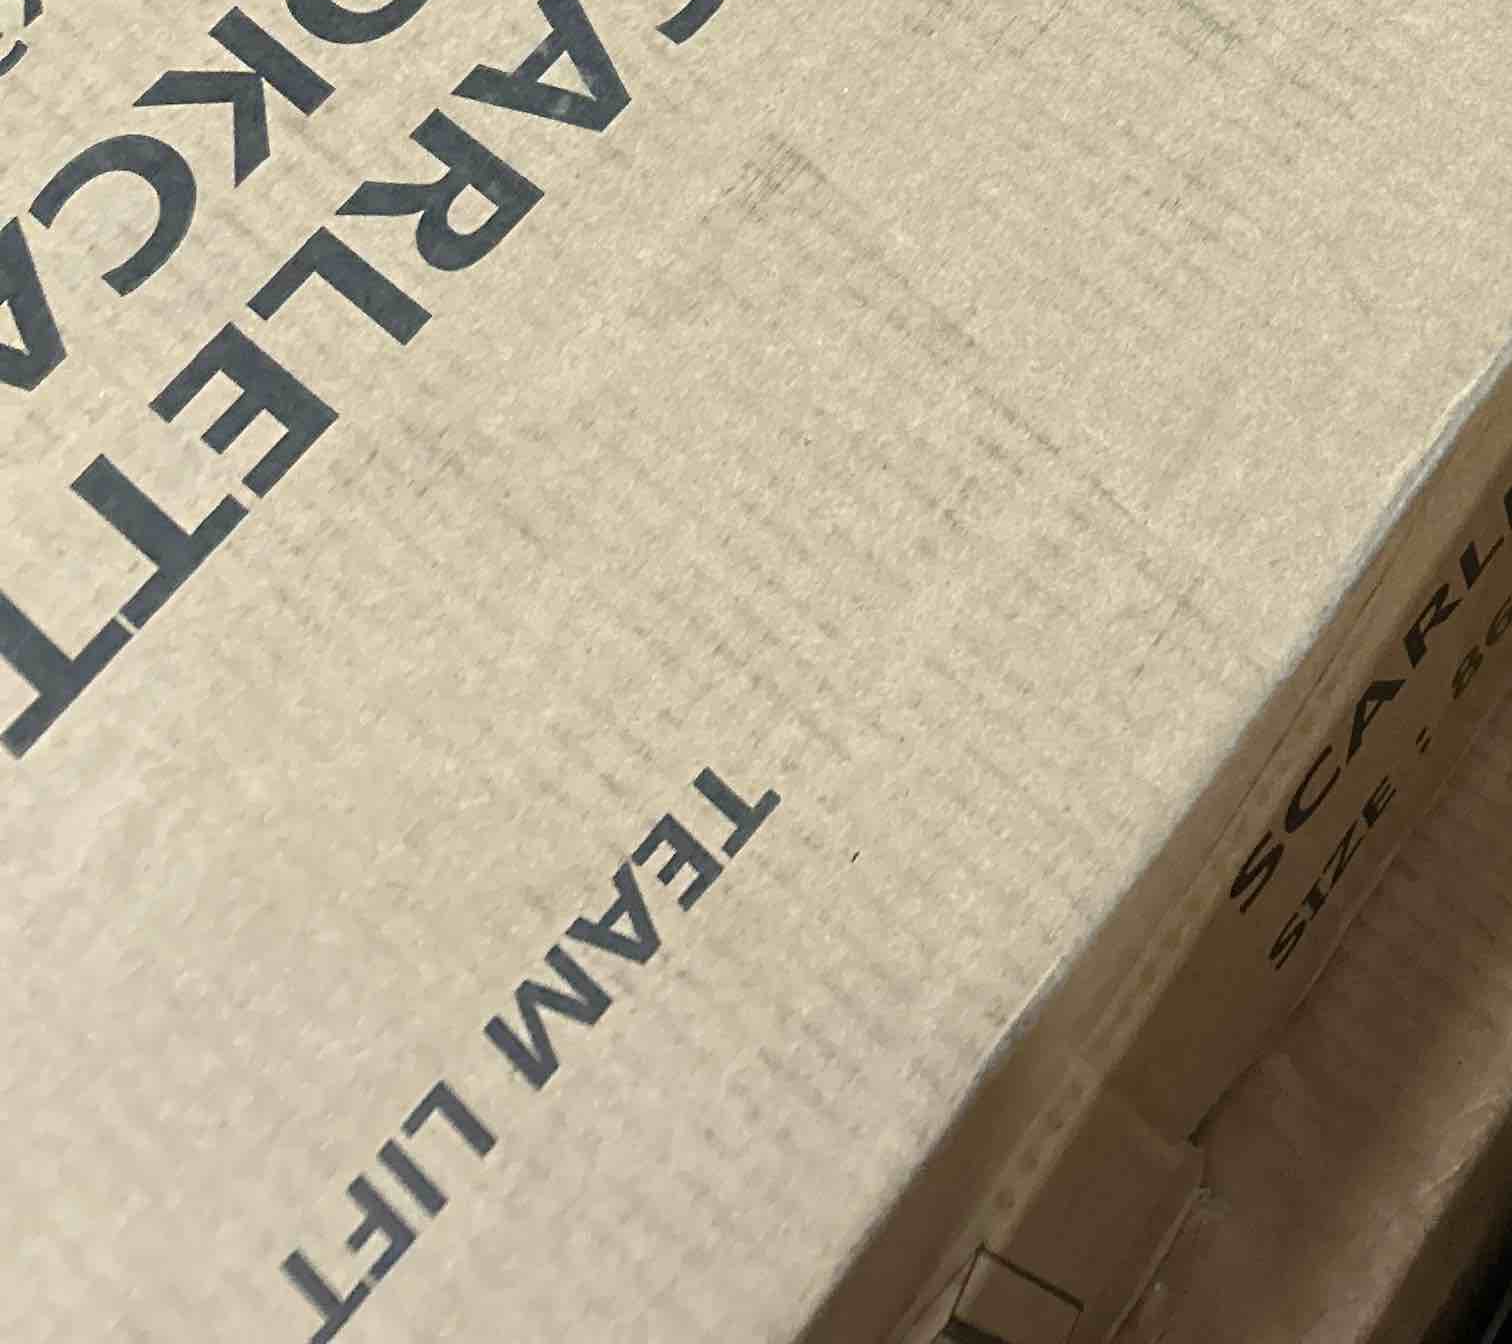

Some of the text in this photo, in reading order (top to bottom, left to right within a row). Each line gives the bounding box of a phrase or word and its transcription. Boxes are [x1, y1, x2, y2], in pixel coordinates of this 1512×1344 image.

[280, 766, 782, 1344] TEAM LIFT
[1268, 775, 1397, 972] SIZE
